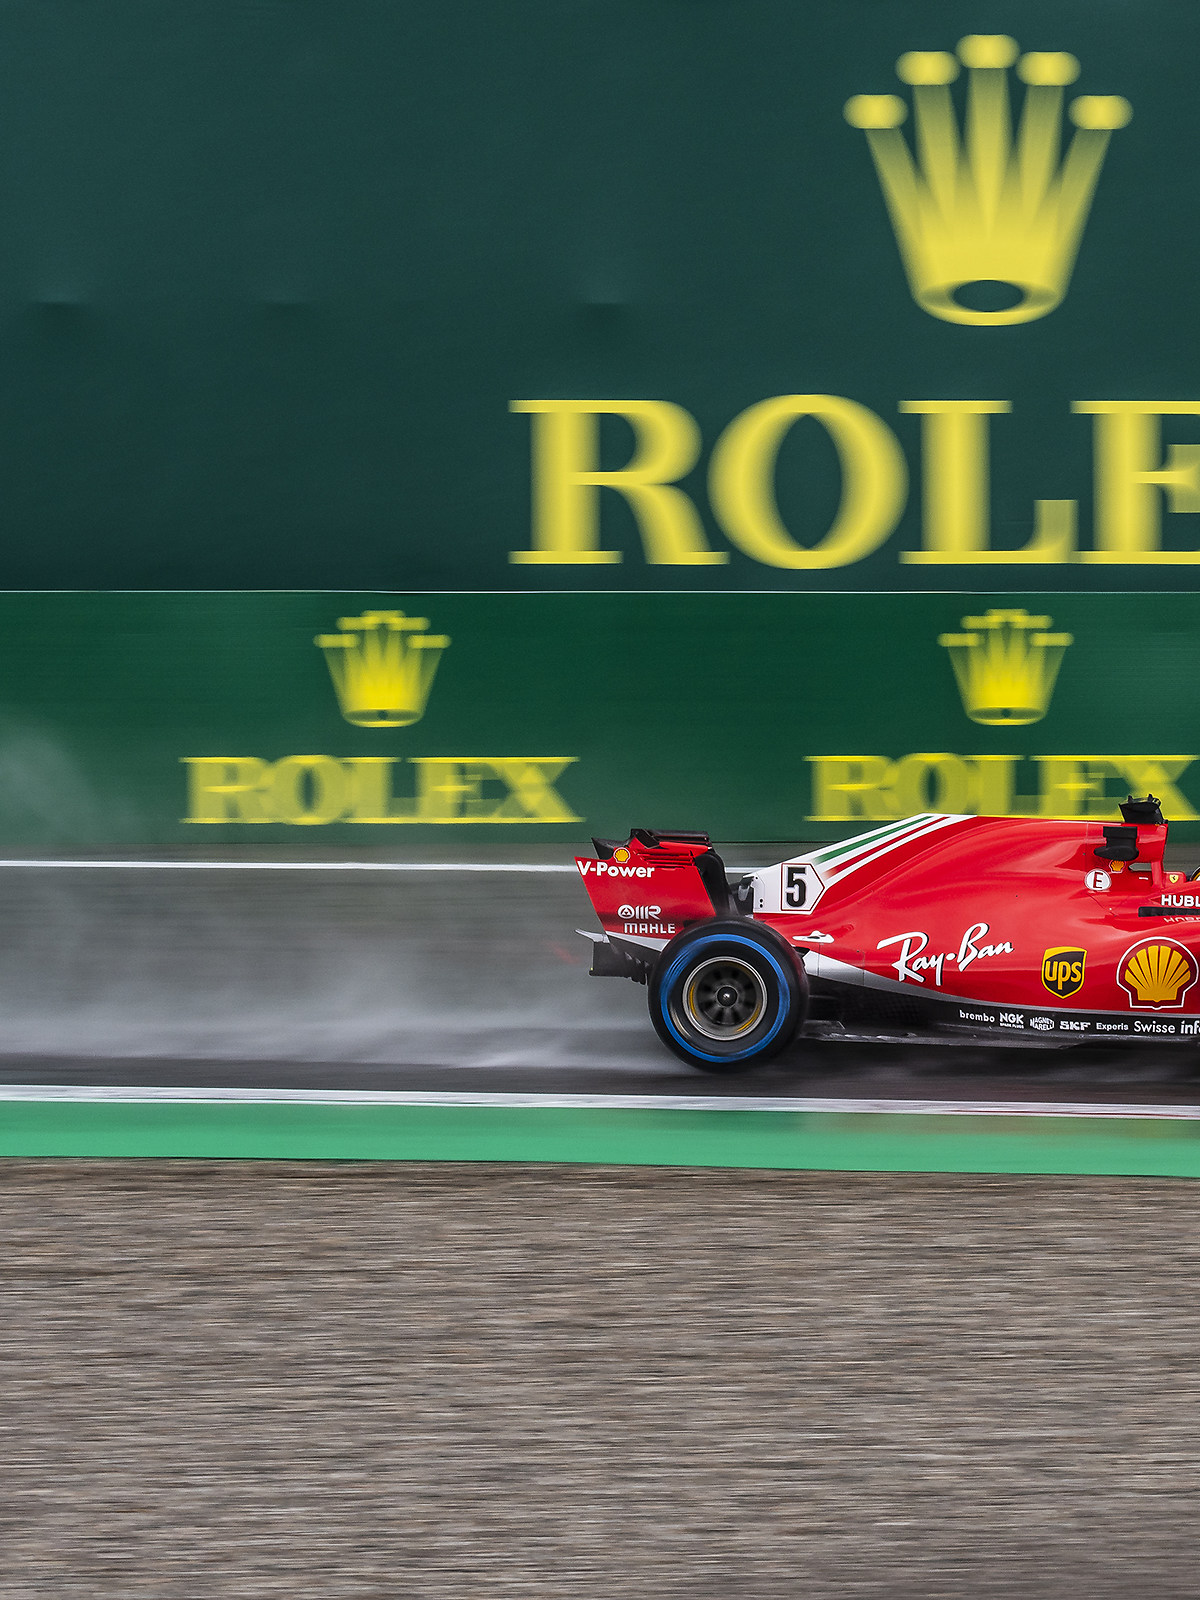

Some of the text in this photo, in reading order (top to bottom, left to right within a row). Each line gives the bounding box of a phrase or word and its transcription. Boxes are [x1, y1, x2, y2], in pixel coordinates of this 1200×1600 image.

[181, 754, 583, 824] ROLEX
[577, 861, 655, 878] V-Power
[785, 865, 807, 908] 5
[1093, 872, 1103, 889] E
[624, 922, 676, 934] MAHLE
[1045, 961, 1082, 990] ups
[960, 1010, 995, 1022] brembo
[1000, 1012, 1024, 1024] NGK
[1060, 1021, 1090, 1030] SKF
[1134, 1020, 1176, 1033] Swisse
